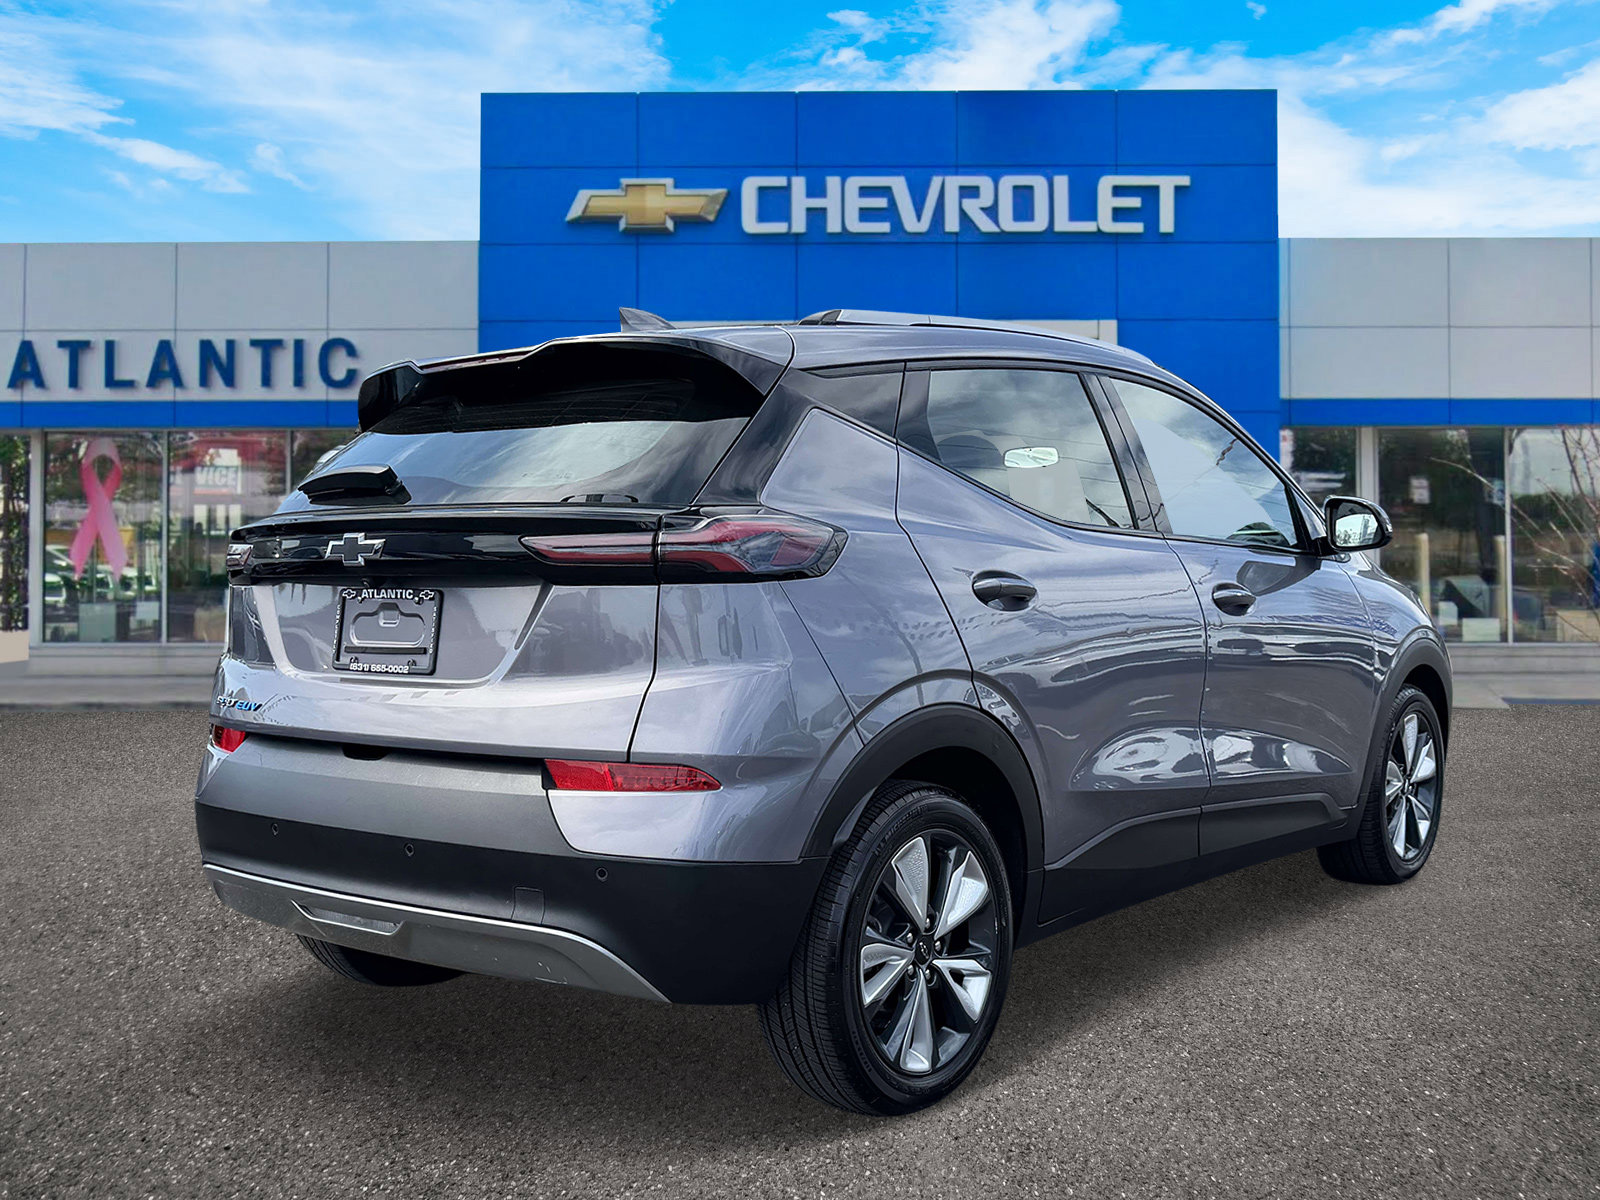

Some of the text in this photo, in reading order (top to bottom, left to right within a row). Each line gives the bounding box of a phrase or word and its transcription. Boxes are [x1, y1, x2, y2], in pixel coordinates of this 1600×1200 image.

[740, 174, 1191, 235] CHEVROLET
[6, 337, 360, 390] ATLANTIC
[361, 588, 414, 599] ATLANTIC
